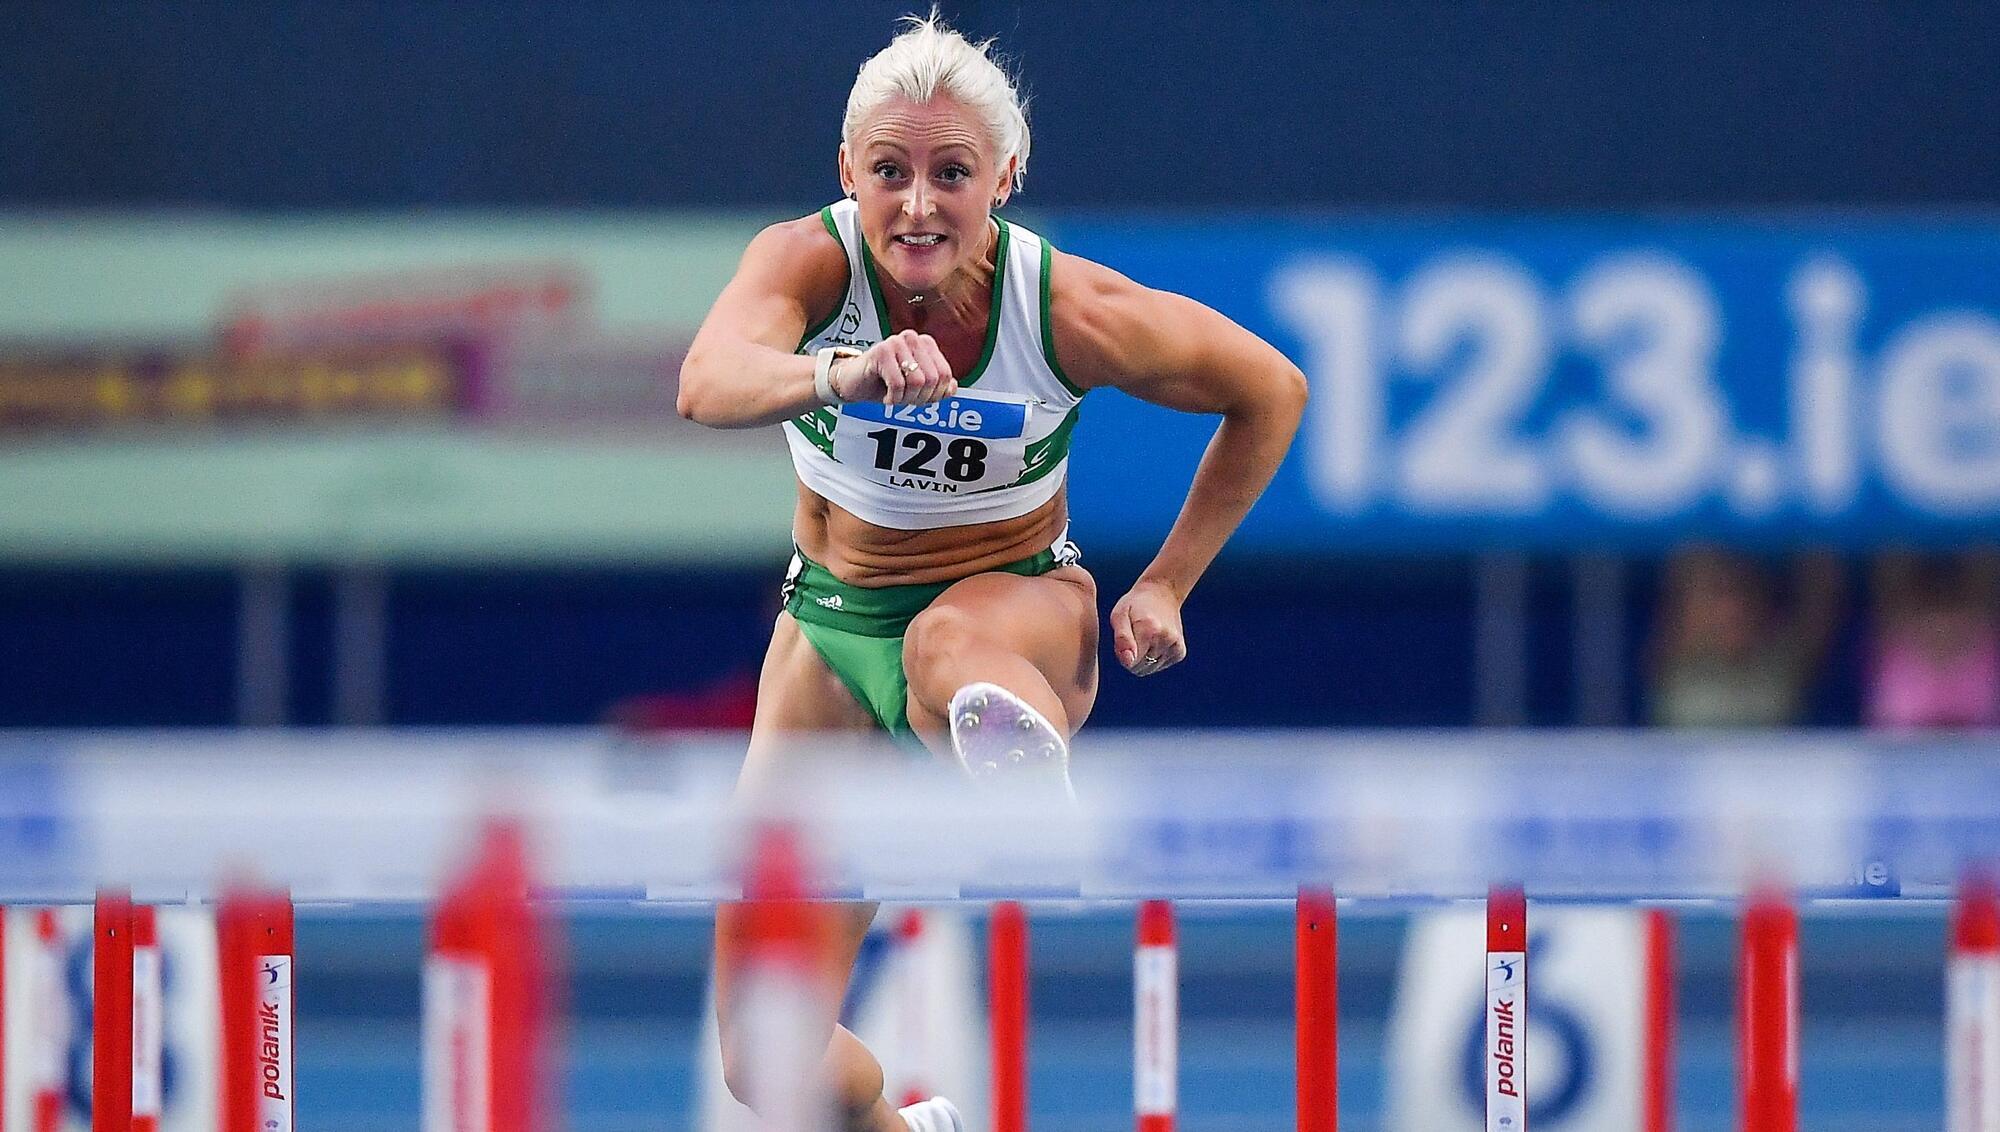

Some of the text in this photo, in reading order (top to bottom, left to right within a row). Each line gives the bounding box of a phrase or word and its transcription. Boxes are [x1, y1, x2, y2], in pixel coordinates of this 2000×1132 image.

[884, 402, 983, 431] 123.ie
[1268, 254, 2000, 512] 123.ie
[867, 427, 988, 482] 128
[890, 476, 958, 493] LAVIN
[259, 1001, 285, 1101] polanik
[1494, 998, 1518, 1098] polanik
